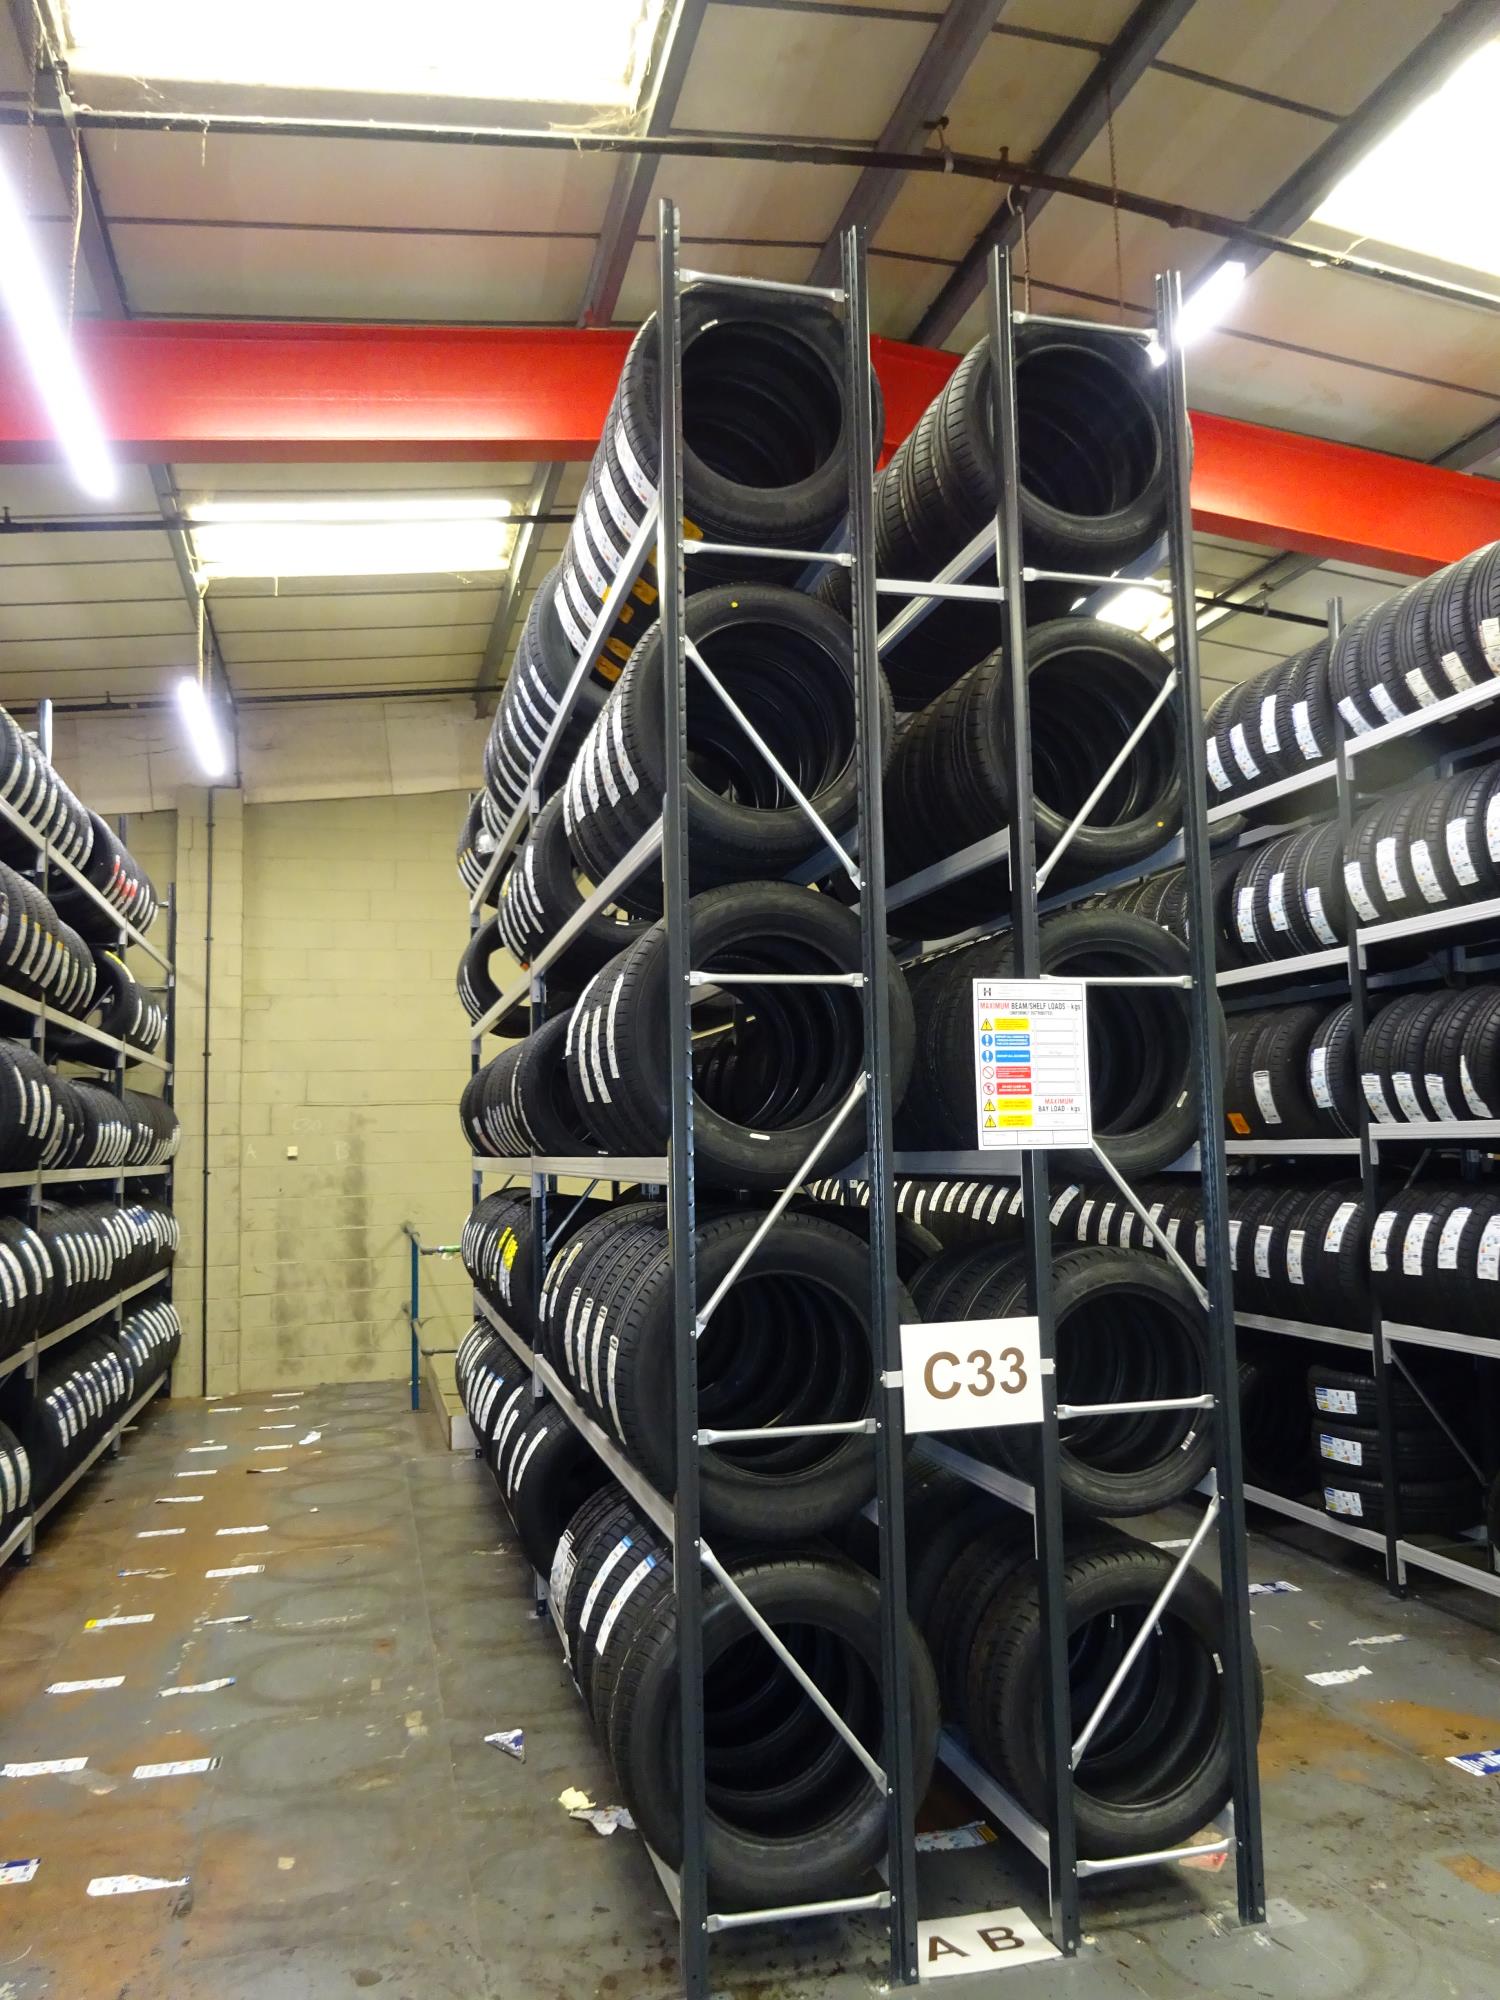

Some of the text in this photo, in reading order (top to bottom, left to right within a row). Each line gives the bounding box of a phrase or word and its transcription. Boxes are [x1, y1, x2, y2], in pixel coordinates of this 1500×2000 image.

[983, 987, 992, 996] H
[1011, 1002, 1047, 1010] BEAM/SHELF
[1048, 1002, 1066, 1010] LOADS
[1071, 1003, 1081, 1011] kgs
[1070, 1105, 1081, 1113] kgs
[924, 1347, 1028, 1400] C33
[928, 1926, 1025, 1962] A B
